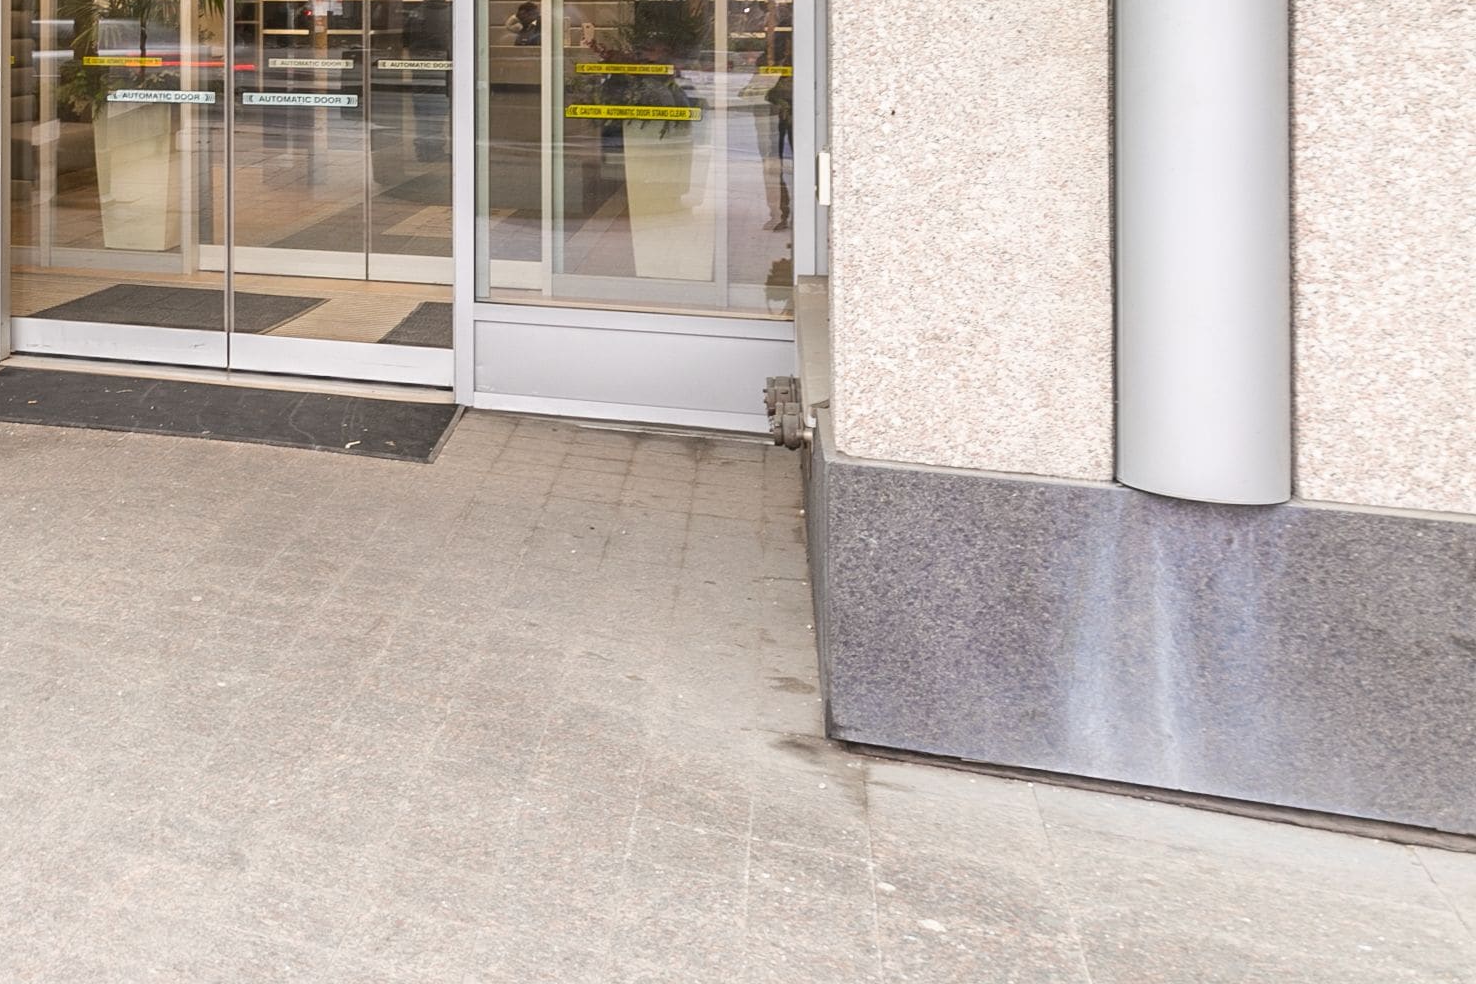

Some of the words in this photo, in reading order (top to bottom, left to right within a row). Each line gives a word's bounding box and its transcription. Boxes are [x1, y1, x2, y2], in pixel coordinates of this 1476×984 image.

[122, 92, 171, 100] AUTOMATIC
[174, 93, 200, 101] DOOR
[259, 95, 312, 103] AUTOMATIC
[314, 96, 342, 104] DOOR
